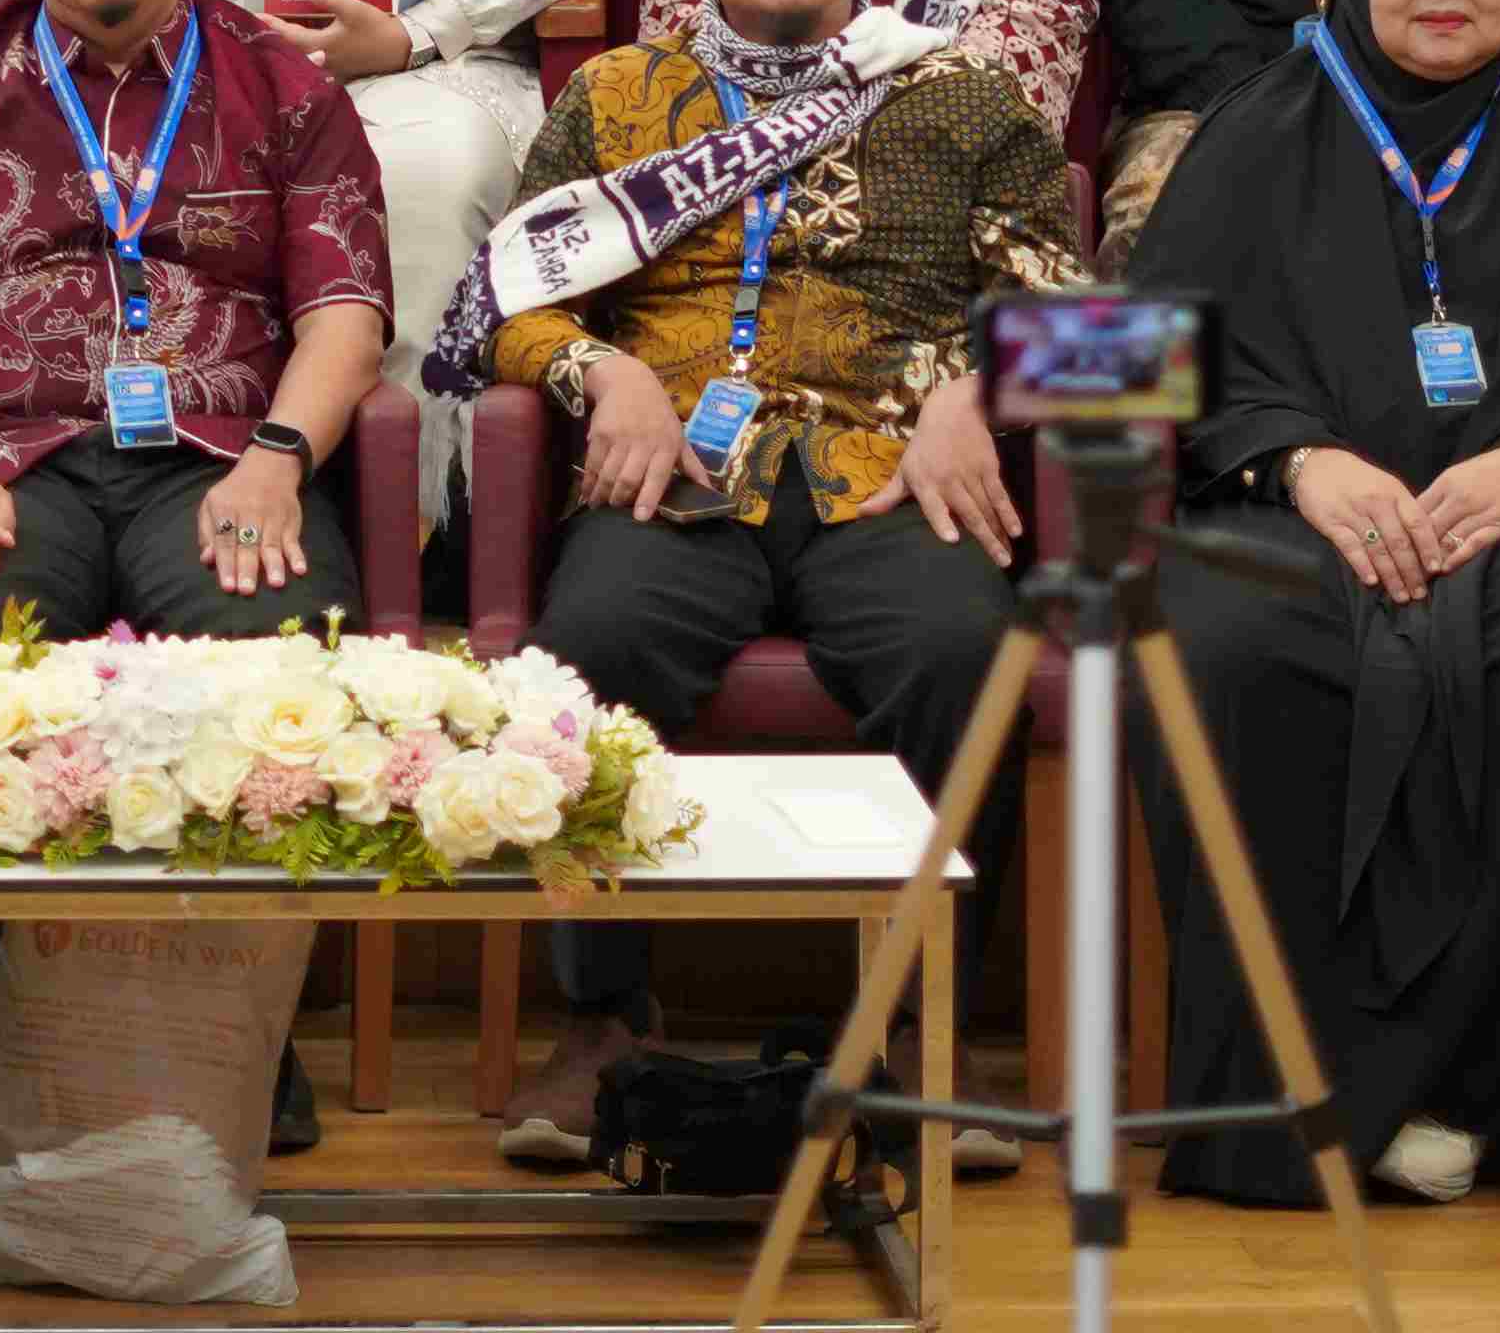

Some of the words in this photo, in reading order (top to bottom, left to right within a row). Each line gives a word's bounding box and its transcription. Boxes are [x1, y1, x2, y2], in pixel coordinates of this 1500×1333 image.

[659, 85, 853, 212] AZ-ZAHR
[79, 925, 188, 965] GOLDEN
[199, 945, 266, 968] WAY
